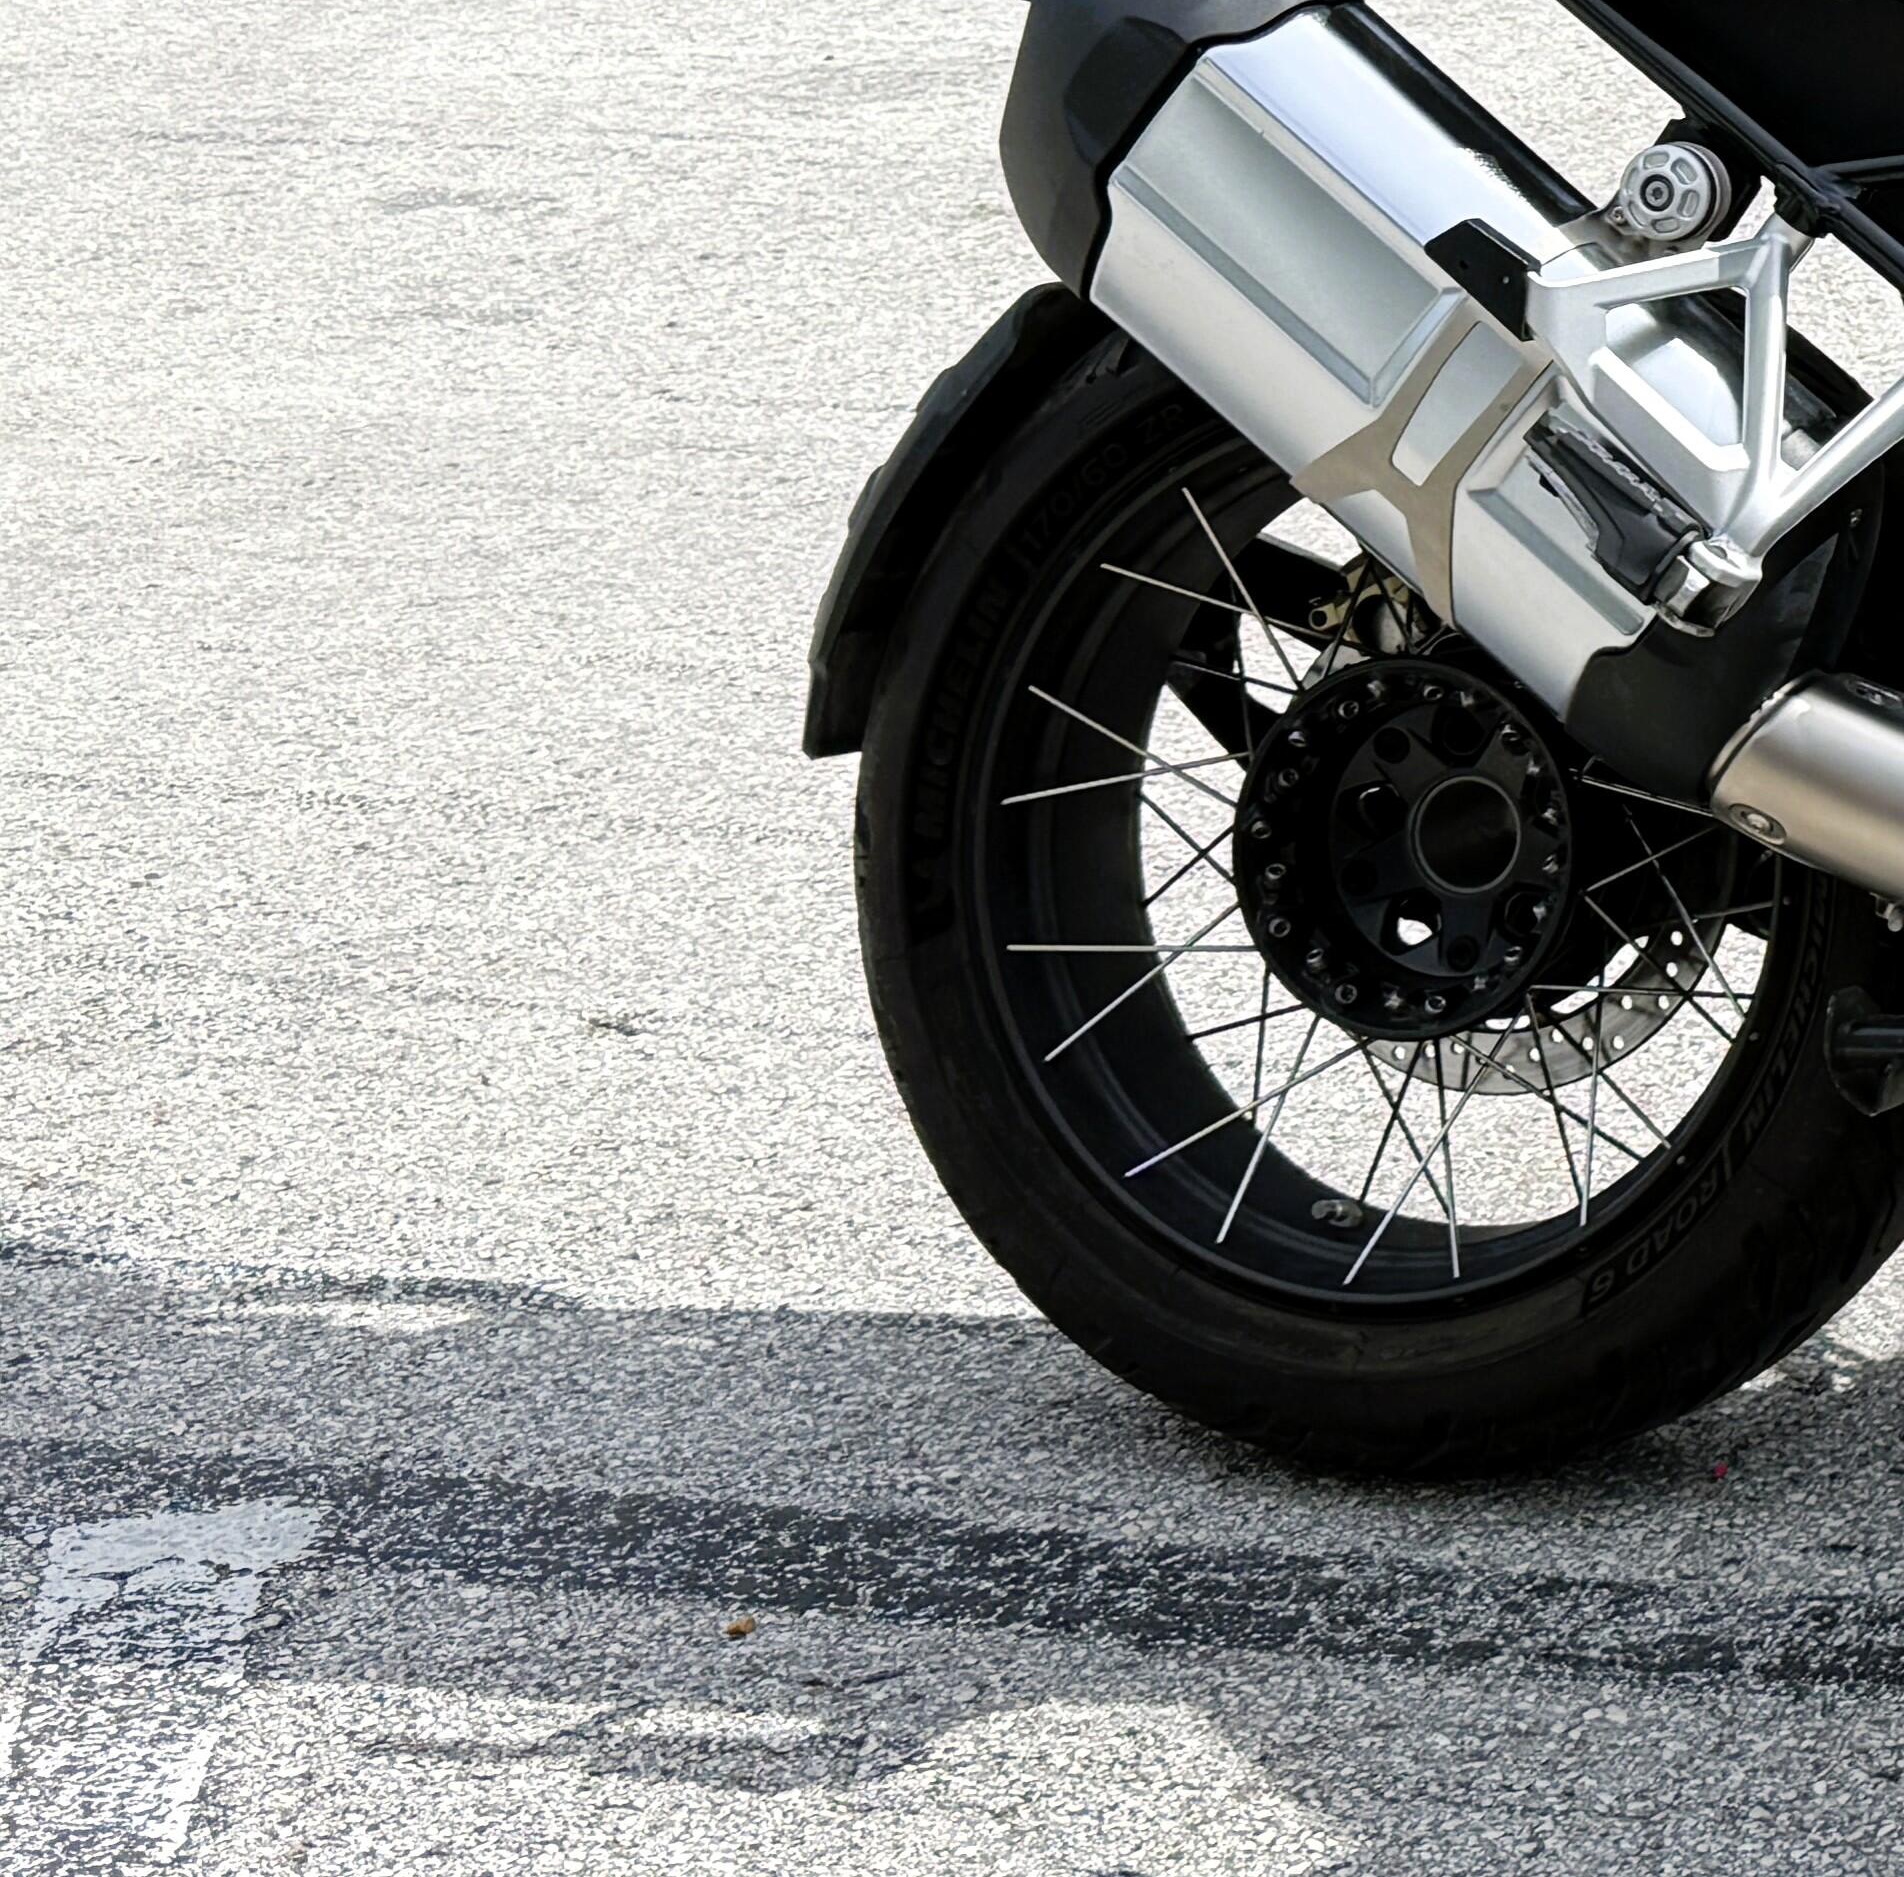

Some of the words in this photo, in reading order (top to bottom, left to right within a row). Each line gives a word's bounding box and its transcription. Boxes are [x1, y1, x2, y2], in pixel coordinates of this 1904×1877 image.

[1020, 440, 1129, 554] 170/60
[1134, 402, 1185, 446] ZR
[1624, 1158, 1720, 1276] ROAD
[1588, 1267, 1616, 1301] 6
